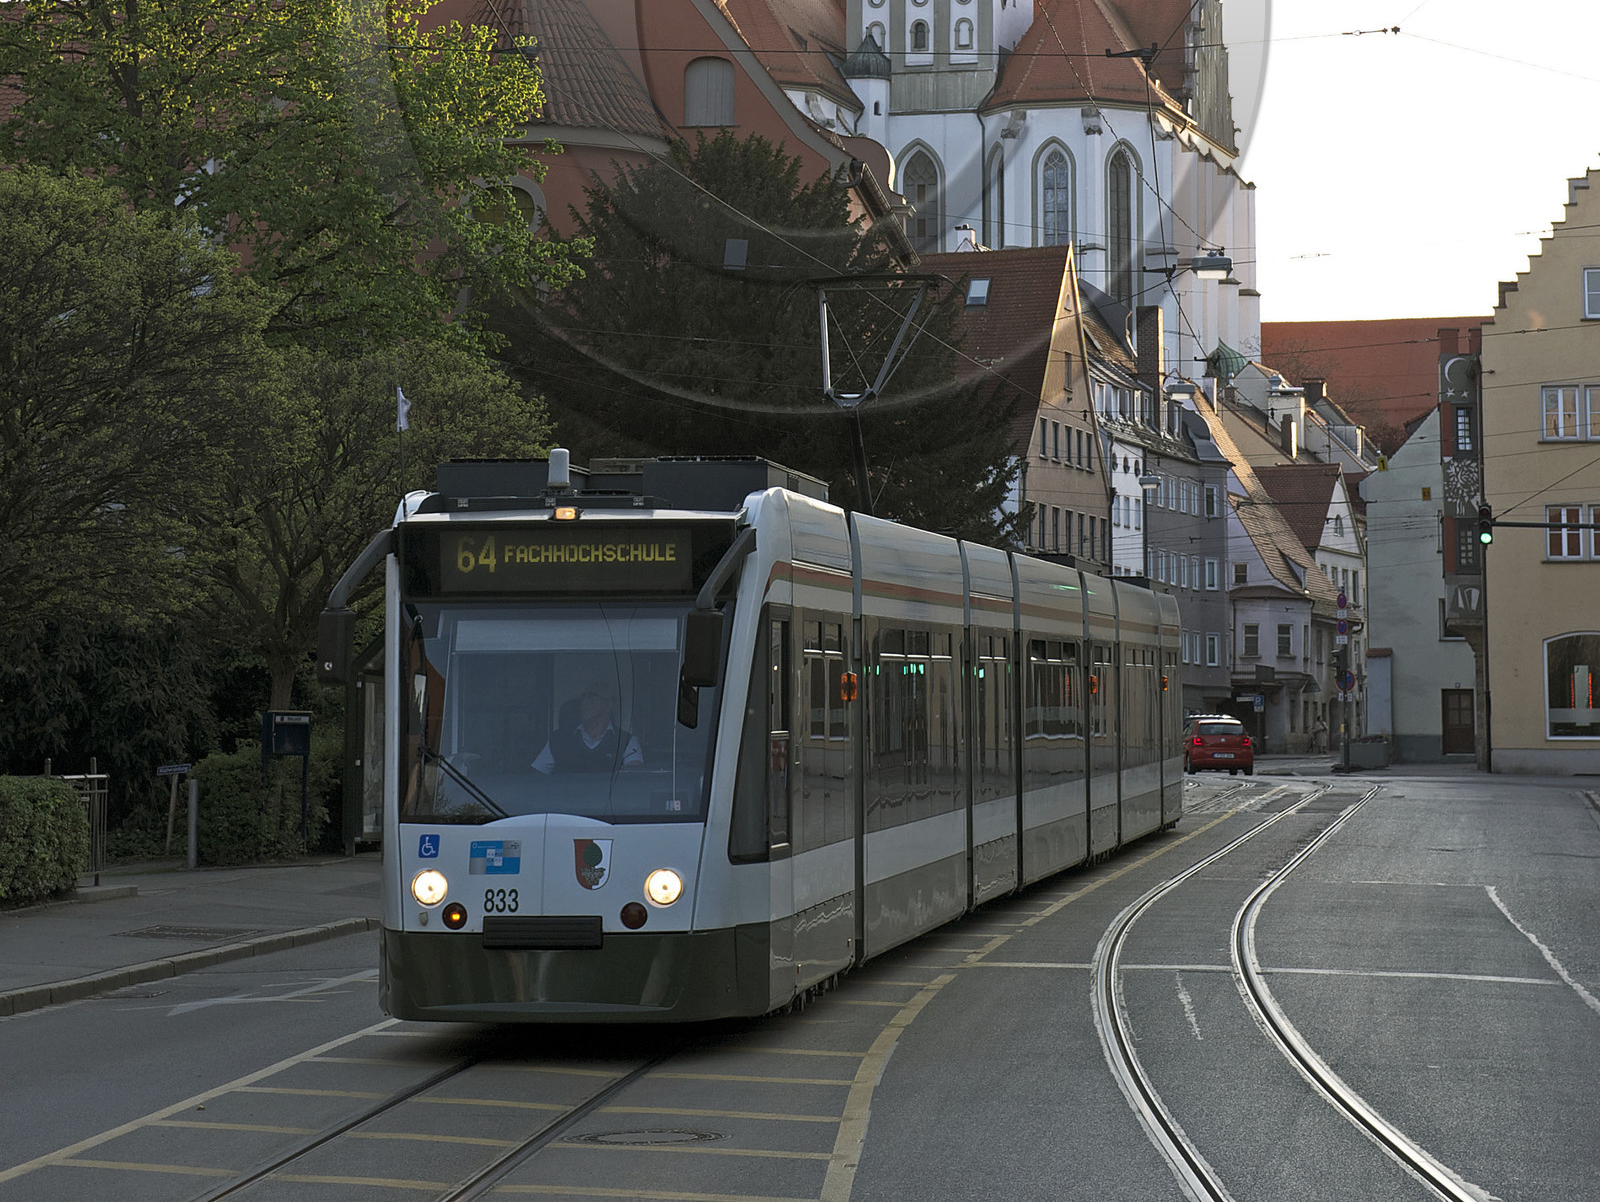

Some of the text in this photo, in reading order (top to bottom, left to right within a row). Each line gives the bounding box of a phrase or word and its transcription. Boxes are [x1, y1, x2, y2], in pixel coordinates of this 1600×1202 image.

[457, 536, 676, 573] 64 FACHHOCHSCHULE
[483, 888, 519, 913] 833
